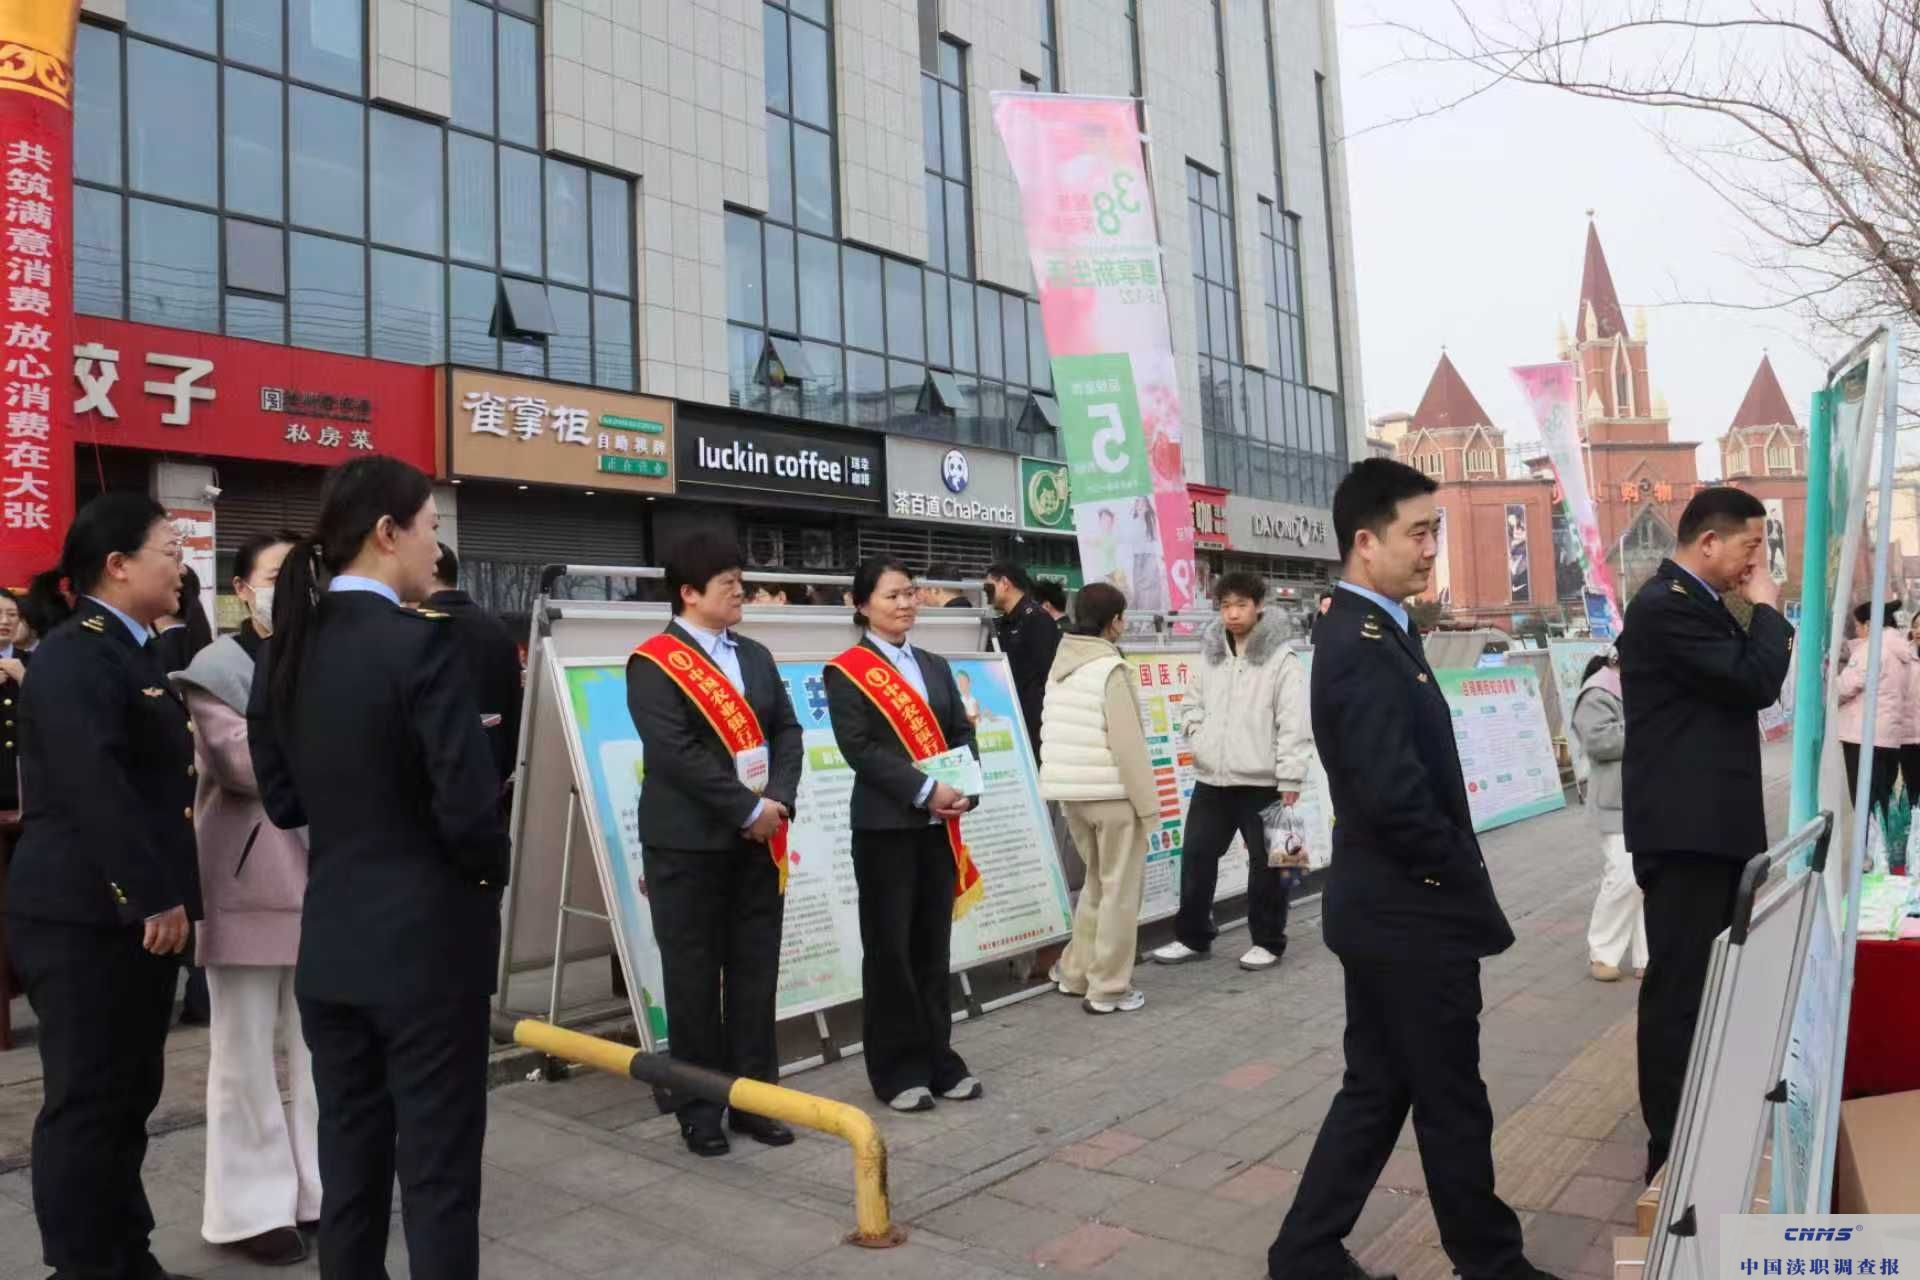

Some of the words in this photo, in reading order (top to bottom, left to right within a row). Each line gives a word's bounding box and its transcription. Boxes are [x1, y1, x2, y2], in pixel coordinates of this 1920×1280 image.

[5, 141, 53, 317] 共筑满意消费
[4, 322, 52, 529] 放心消费在大张
[285, 423, 373, 450] 私房菜
[699, 437, 768, 474] luckin
[775, 451, 841, 482] coffee
[895, 490, 941, 517] 茶百道
[943, 497, 1015, 524] ChaPanda
